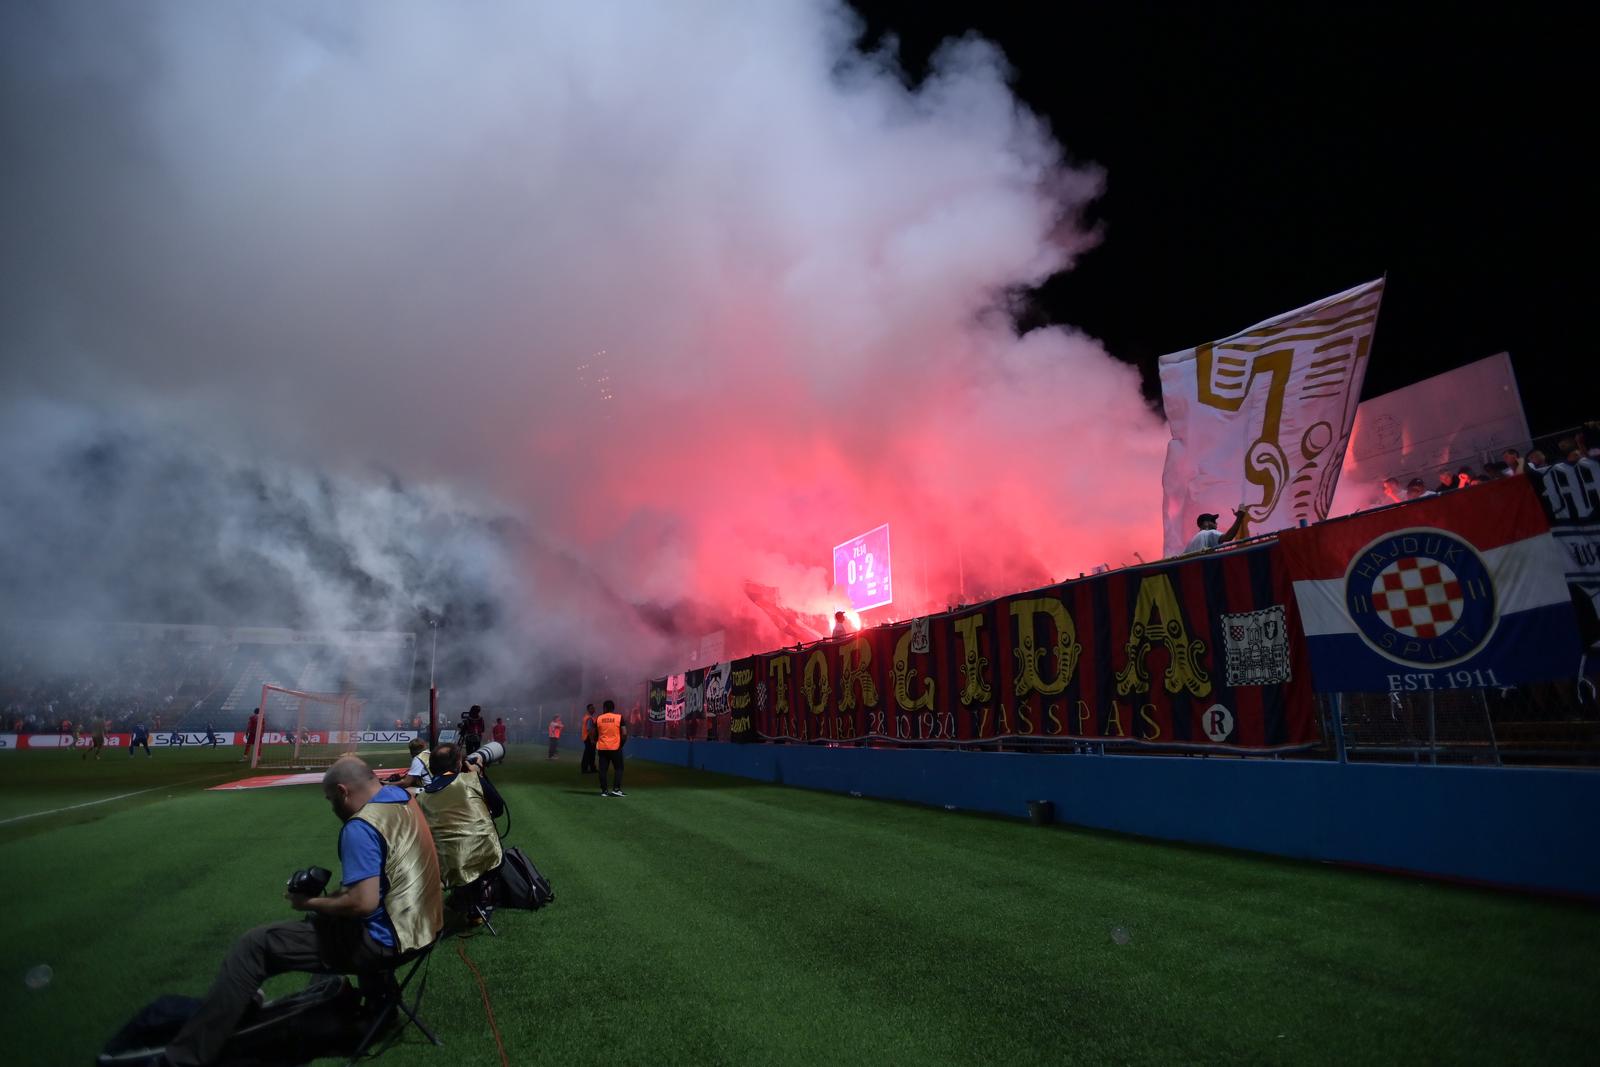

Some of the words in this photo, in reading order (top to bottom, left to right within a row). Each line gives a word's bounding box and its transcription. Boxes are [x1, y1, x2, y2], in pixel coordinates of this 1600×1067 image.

[1357, 536, 1465, 578] HAJDUK
[770, 574, 1212, 714] TORCIDA
[1379, 627, 1475, 661] SPLIT
[1445, 667, 1502, 689] 1911
[349, 732, 411, 742] SOLVIS
[1210, 711, 1225, 735] R
